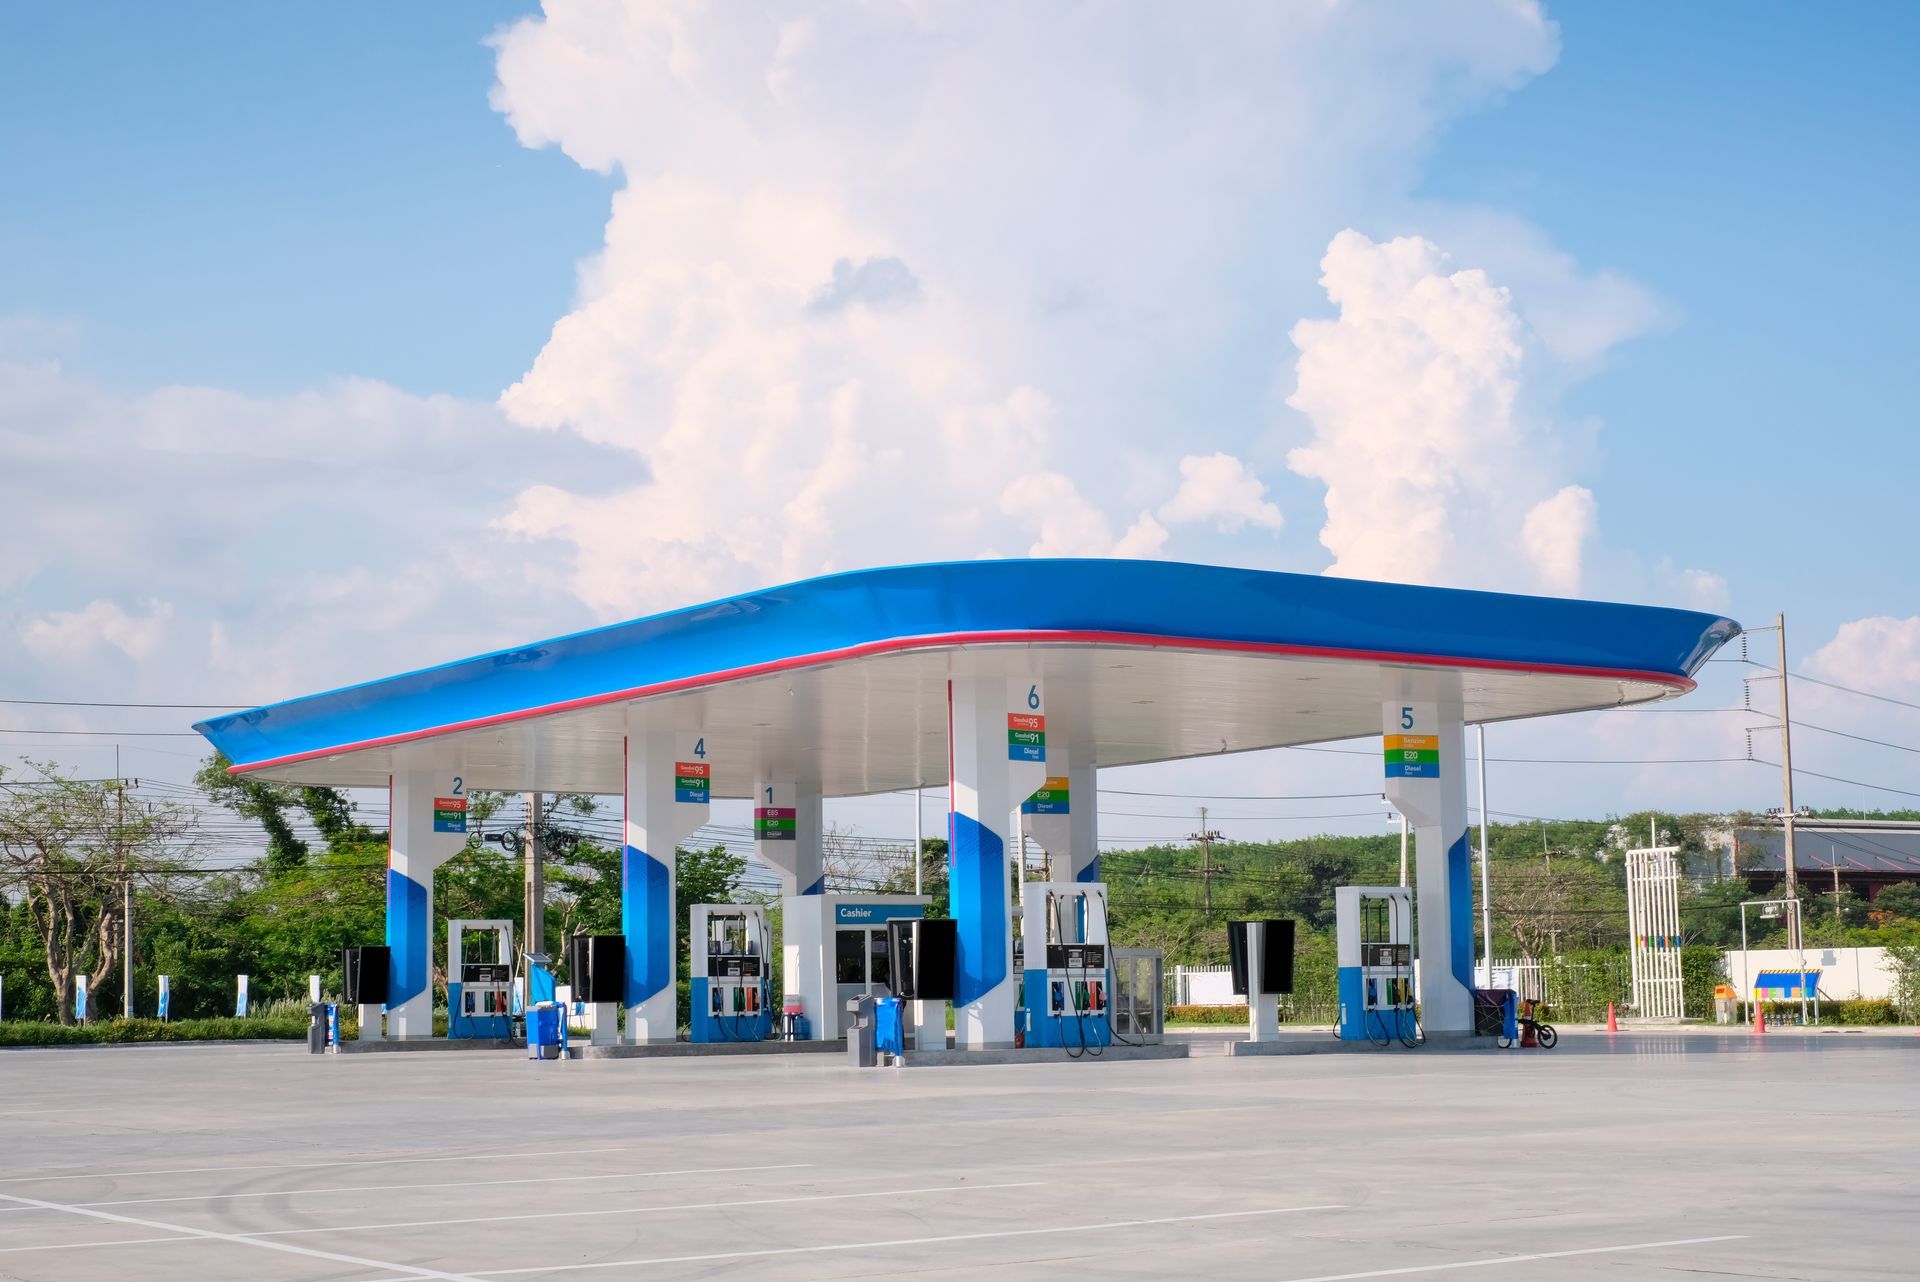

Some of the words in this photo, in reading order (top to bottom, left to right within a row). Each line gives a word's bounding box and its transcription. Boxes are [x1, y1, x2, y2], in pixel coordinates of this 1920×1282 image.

[1028, 685, 1040, 709] 6
[1028, 718, 1039, 728] 95
[1401, 707, 1414, 730] 5
[1030, 733, 1039, 744] 91
[694, 738, 706, 759] 4
[1023, 747, 1039, 755] Diesel
[1404, 751, 1418, 759] E20
[694, 766, 704, 774] 95
[453, 777, 463, 795] 2
[695, 779, 704, 788] 91
[765, 787, 773, 804] 1
[452, 800, 462, 809] 95
[453, 811, 462, 820] 91
[840, 908, 872, 918] Cashier
